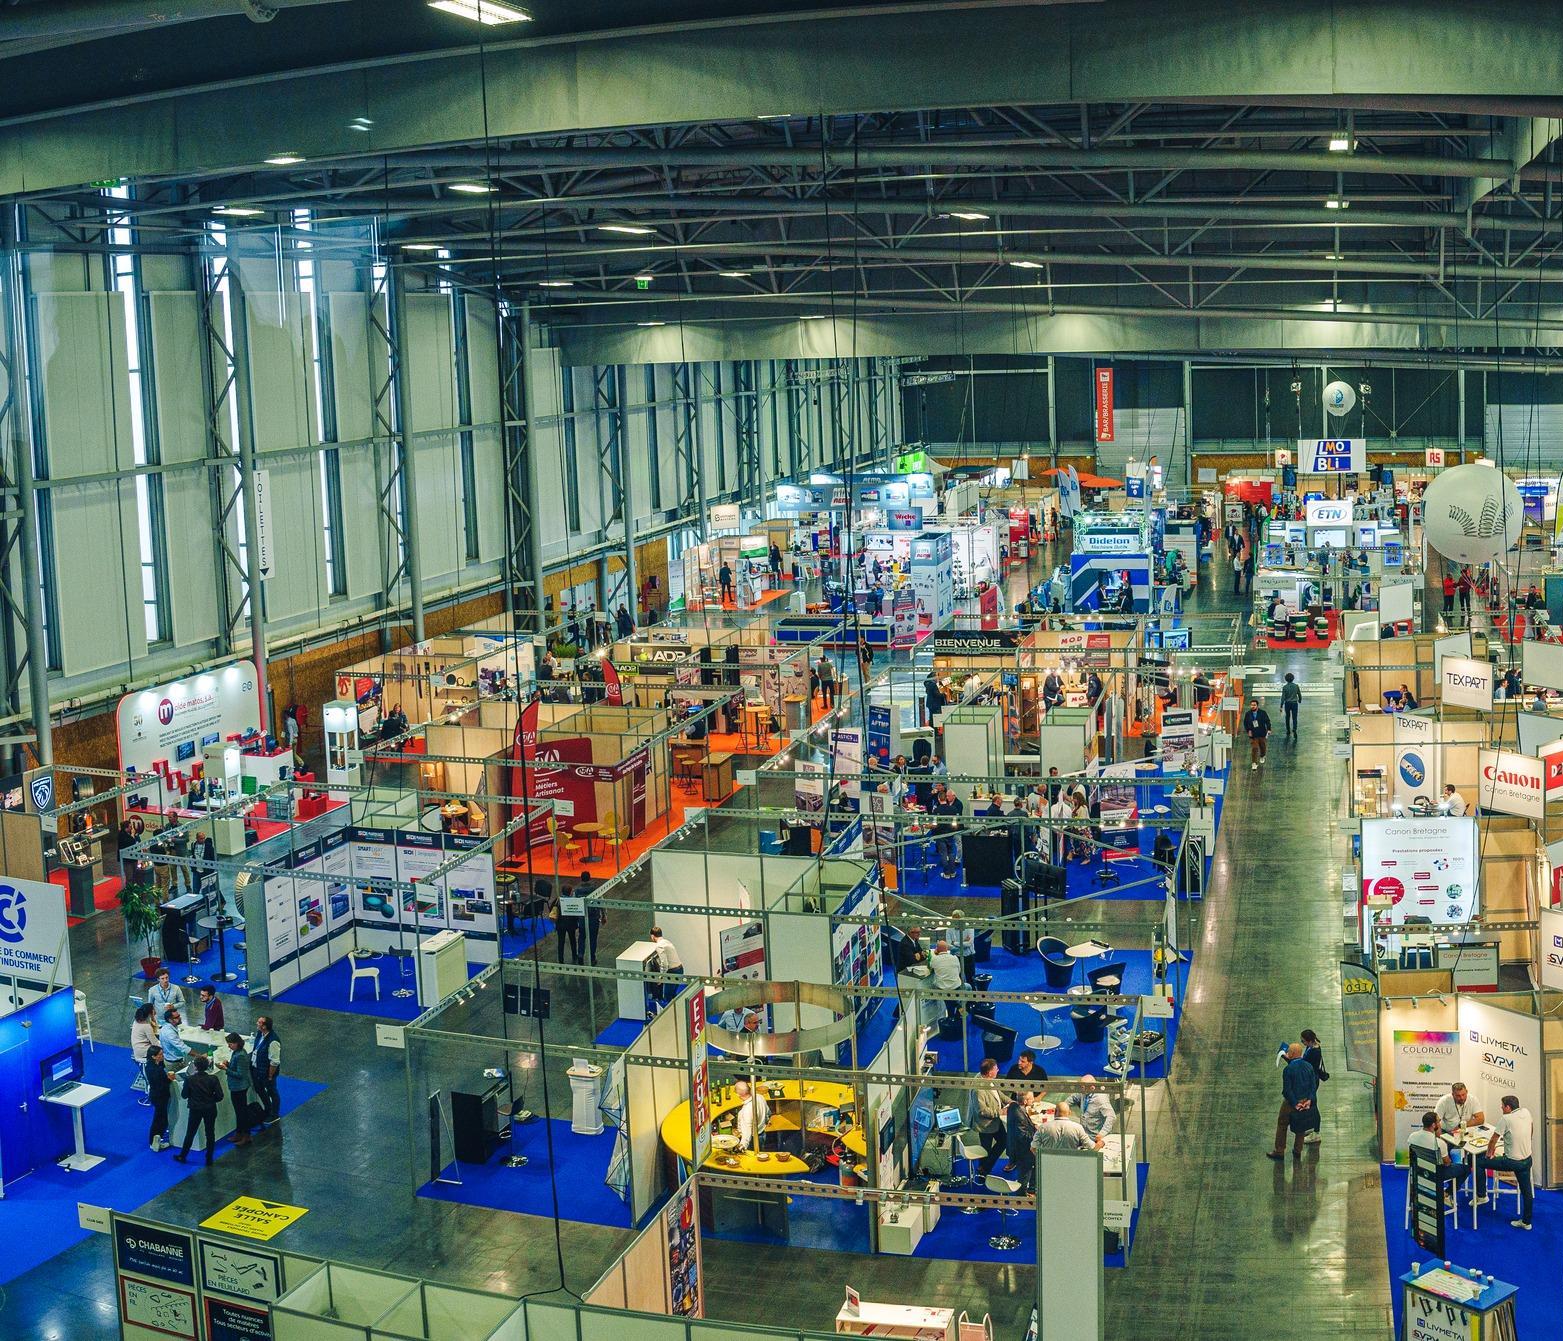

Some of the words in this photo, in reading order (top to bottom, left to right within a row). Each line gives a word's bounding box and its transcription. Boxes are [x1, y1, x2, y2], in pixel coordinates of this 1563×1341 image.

[1429, 453, 1441, 463] RS
[256, 472, 267, 566] TOILETTES
[1317, 509, 1342, 519] ETN
[1089, 536, 1130, 545] Didelon
[934, 639, 1001, 647] BIENVENUE
[1446, 672, 1488, 690] TEXPART
[1397, 716, 1429, 732] TEXPART
[832, 733, 853, 741] PASTICS
[1483, 765, 1541, 790] Canon
[535, 788, 564, 798] Artisanat
[1484, 785, 1507, 796] Canon
[1509, 790, 1541, 803] Bretagne
[1385, 827, 1411, 836] Canon
[1413, 827, 1448, 837] Bretagne
[4, 949, 14, 958] DE
[1402, 1045, 1453, 1055] COLORALU
[1481, 1034, 1528, 1056] LIVMETAL
[1484, 1053, 1514, 1070] SVPM
[1480, 1071, 1516, 1089] COLORALU
[231, 1205, 290, 1221] CANOPÉE
[233, 1213, 272, 1225] SALLE
[138, 1239, 184, 1258] CHABANNE
[218, 1274, 239, 1285] PIÈCES
[128, 1283, 147, 1294] PIÈCES
[218, 1281, 250, 1295] FEUILLARD
[223, 1309, 241, 1319] Toutes
[241, 1313, 264, 1324] nuances
[213, 1318, 227, 1327] Tous
[226, 1320, 249, 1331] secteurs
[249, 1326, 273, 1338] d'activit
[236, 1318, 260, 1329] matières
